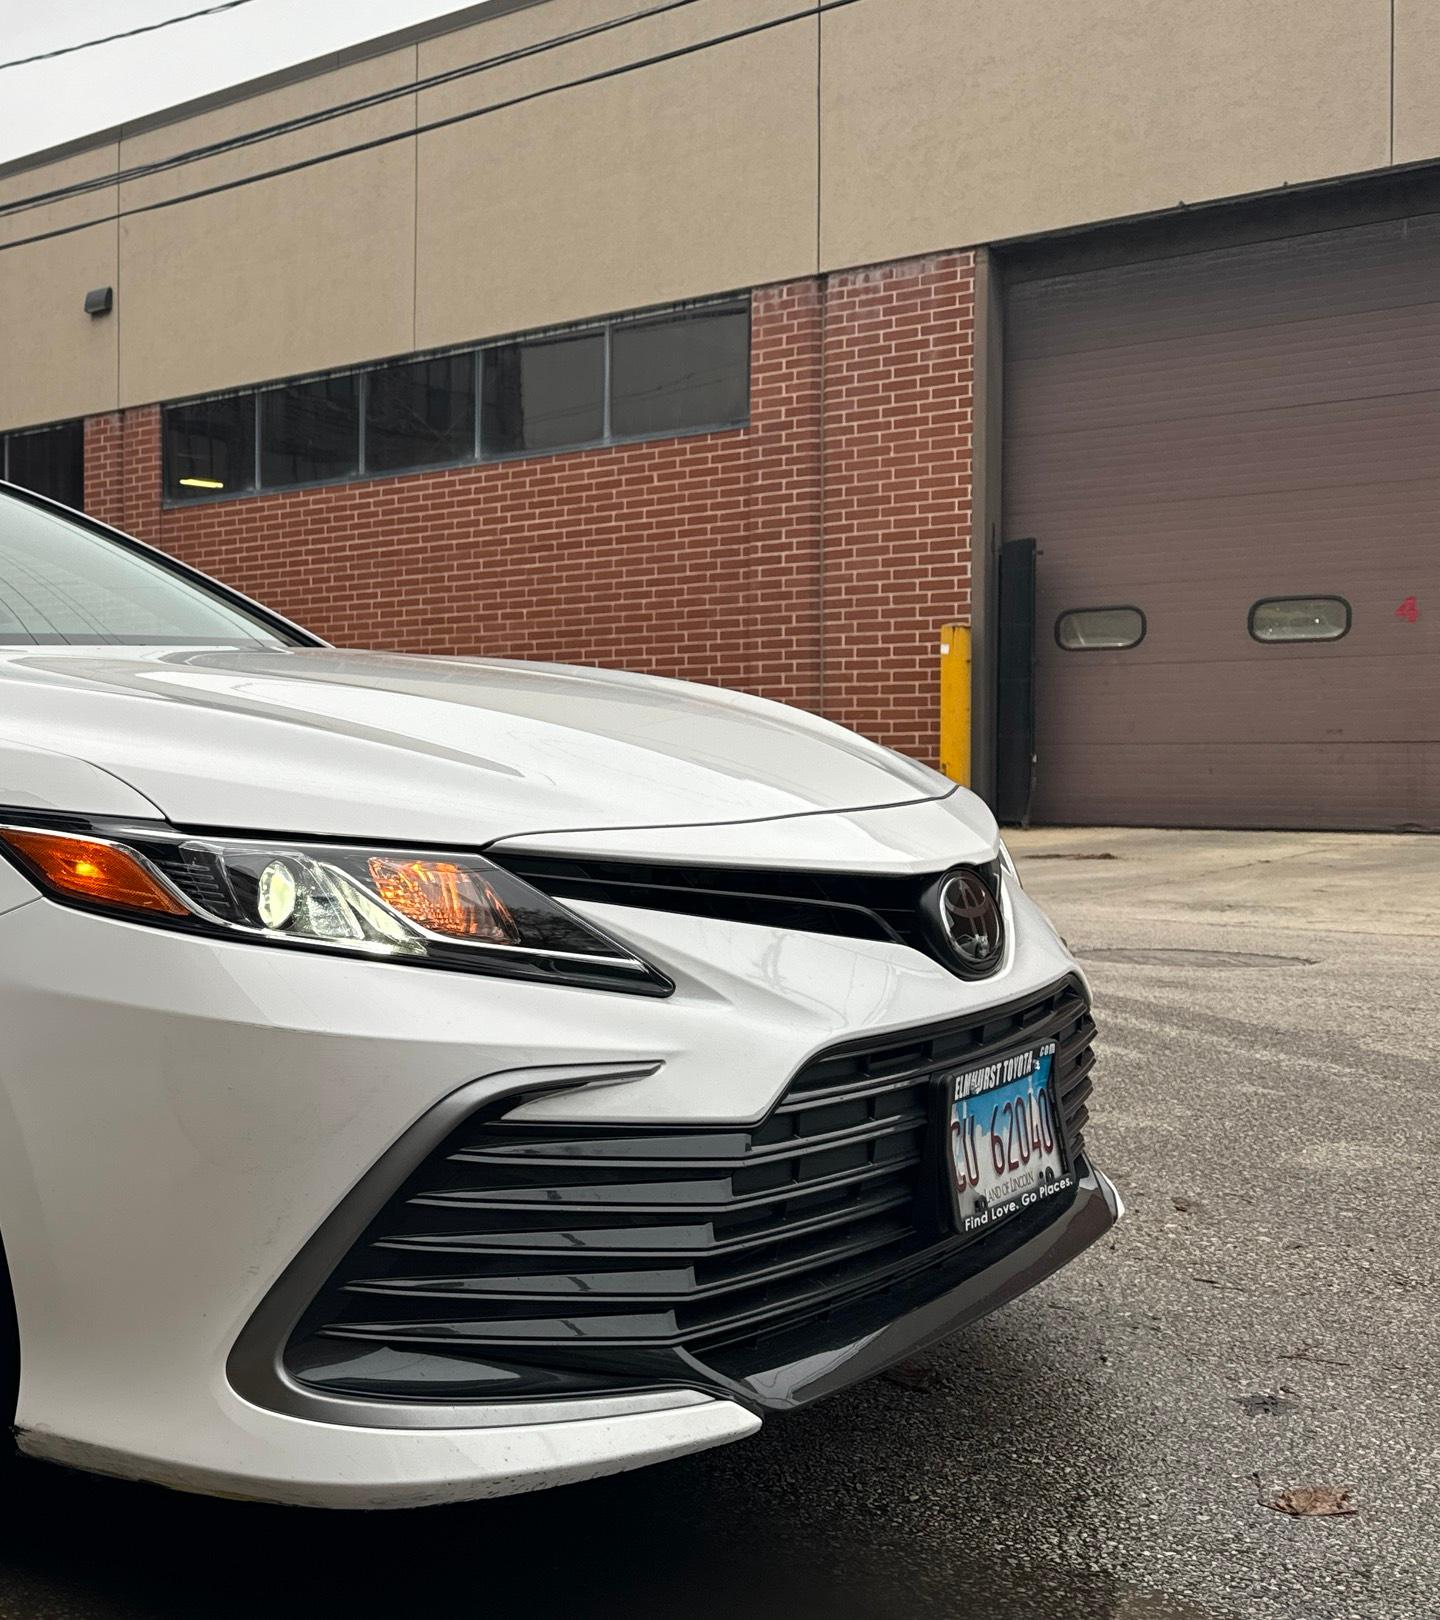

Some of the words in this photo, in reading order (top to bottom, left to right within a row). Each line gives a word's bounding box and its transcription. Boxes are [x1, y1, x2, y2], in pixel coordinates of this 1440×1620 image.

[1394, 595, 1419, 624] 4
[954, 1062, 1002, 1101] ELMHURST
[1002, 1050, 1033, 1083] TOYOTA
[990, 1087, 1054, 1176] 62040
[964, 1211, 988, 1232] Find
[991, 1202, 1020, 1220] Love.
[1021, 1192, 1037, 1206] Go
[1039, 1177, 1073, 1199] Places.
[984, 1183, 1001, 1203] LAND
[1009, 1169, 1035, 1193] LINCOLN
